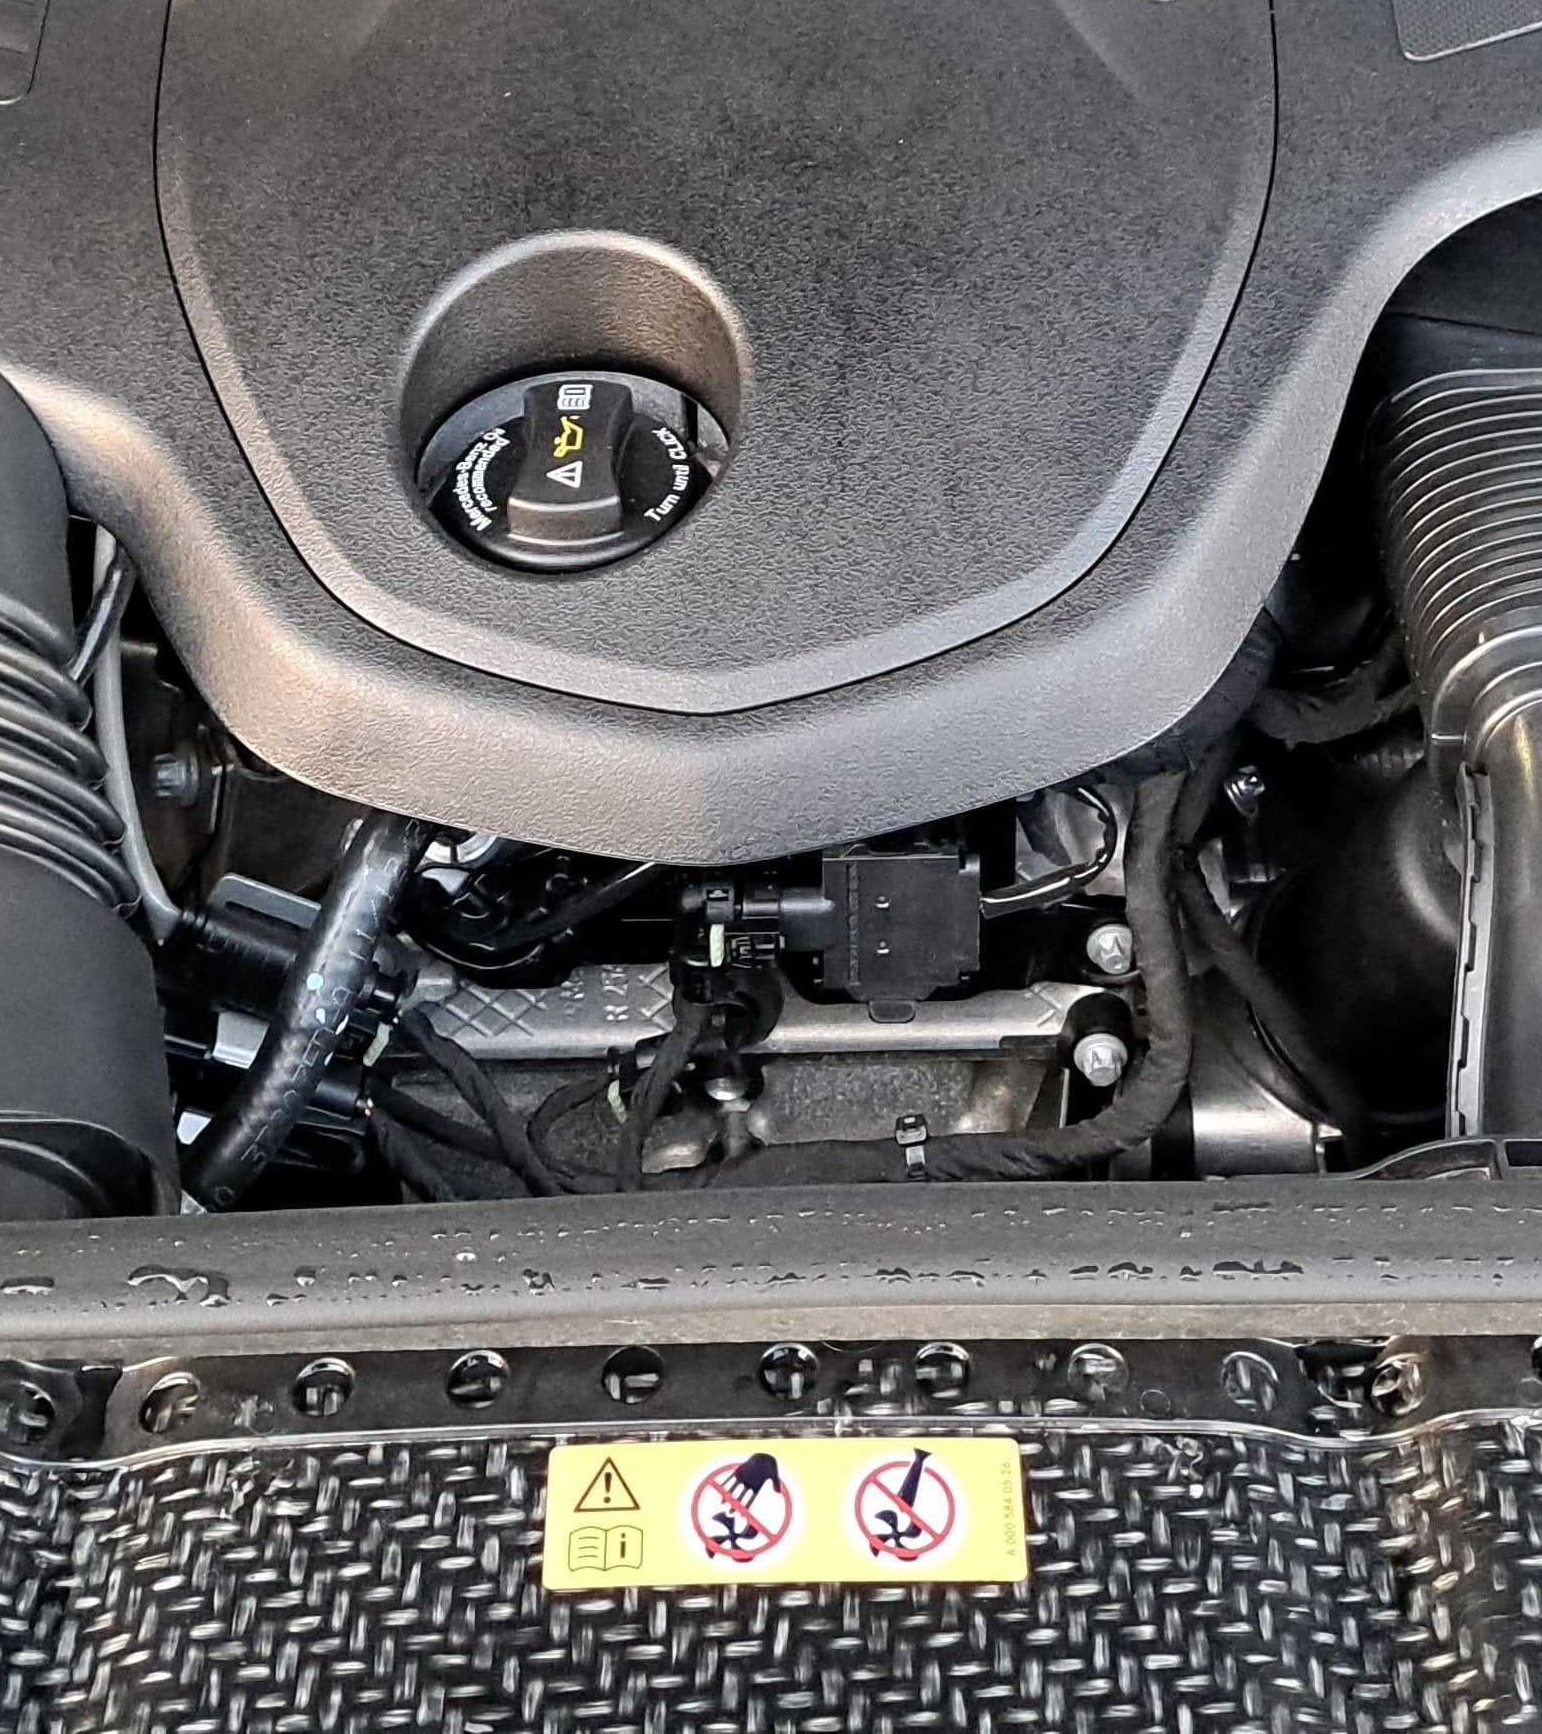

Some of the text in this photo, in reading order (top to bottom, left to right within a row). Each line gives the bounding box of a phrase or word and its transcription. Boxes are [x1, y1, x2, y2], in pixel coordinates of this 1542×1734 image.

[452, 440, 492, 531] Mercedes-Benz
[471, 437, 511, 513] recommended
[644, 426, 690, 523] Turn until CLICK
